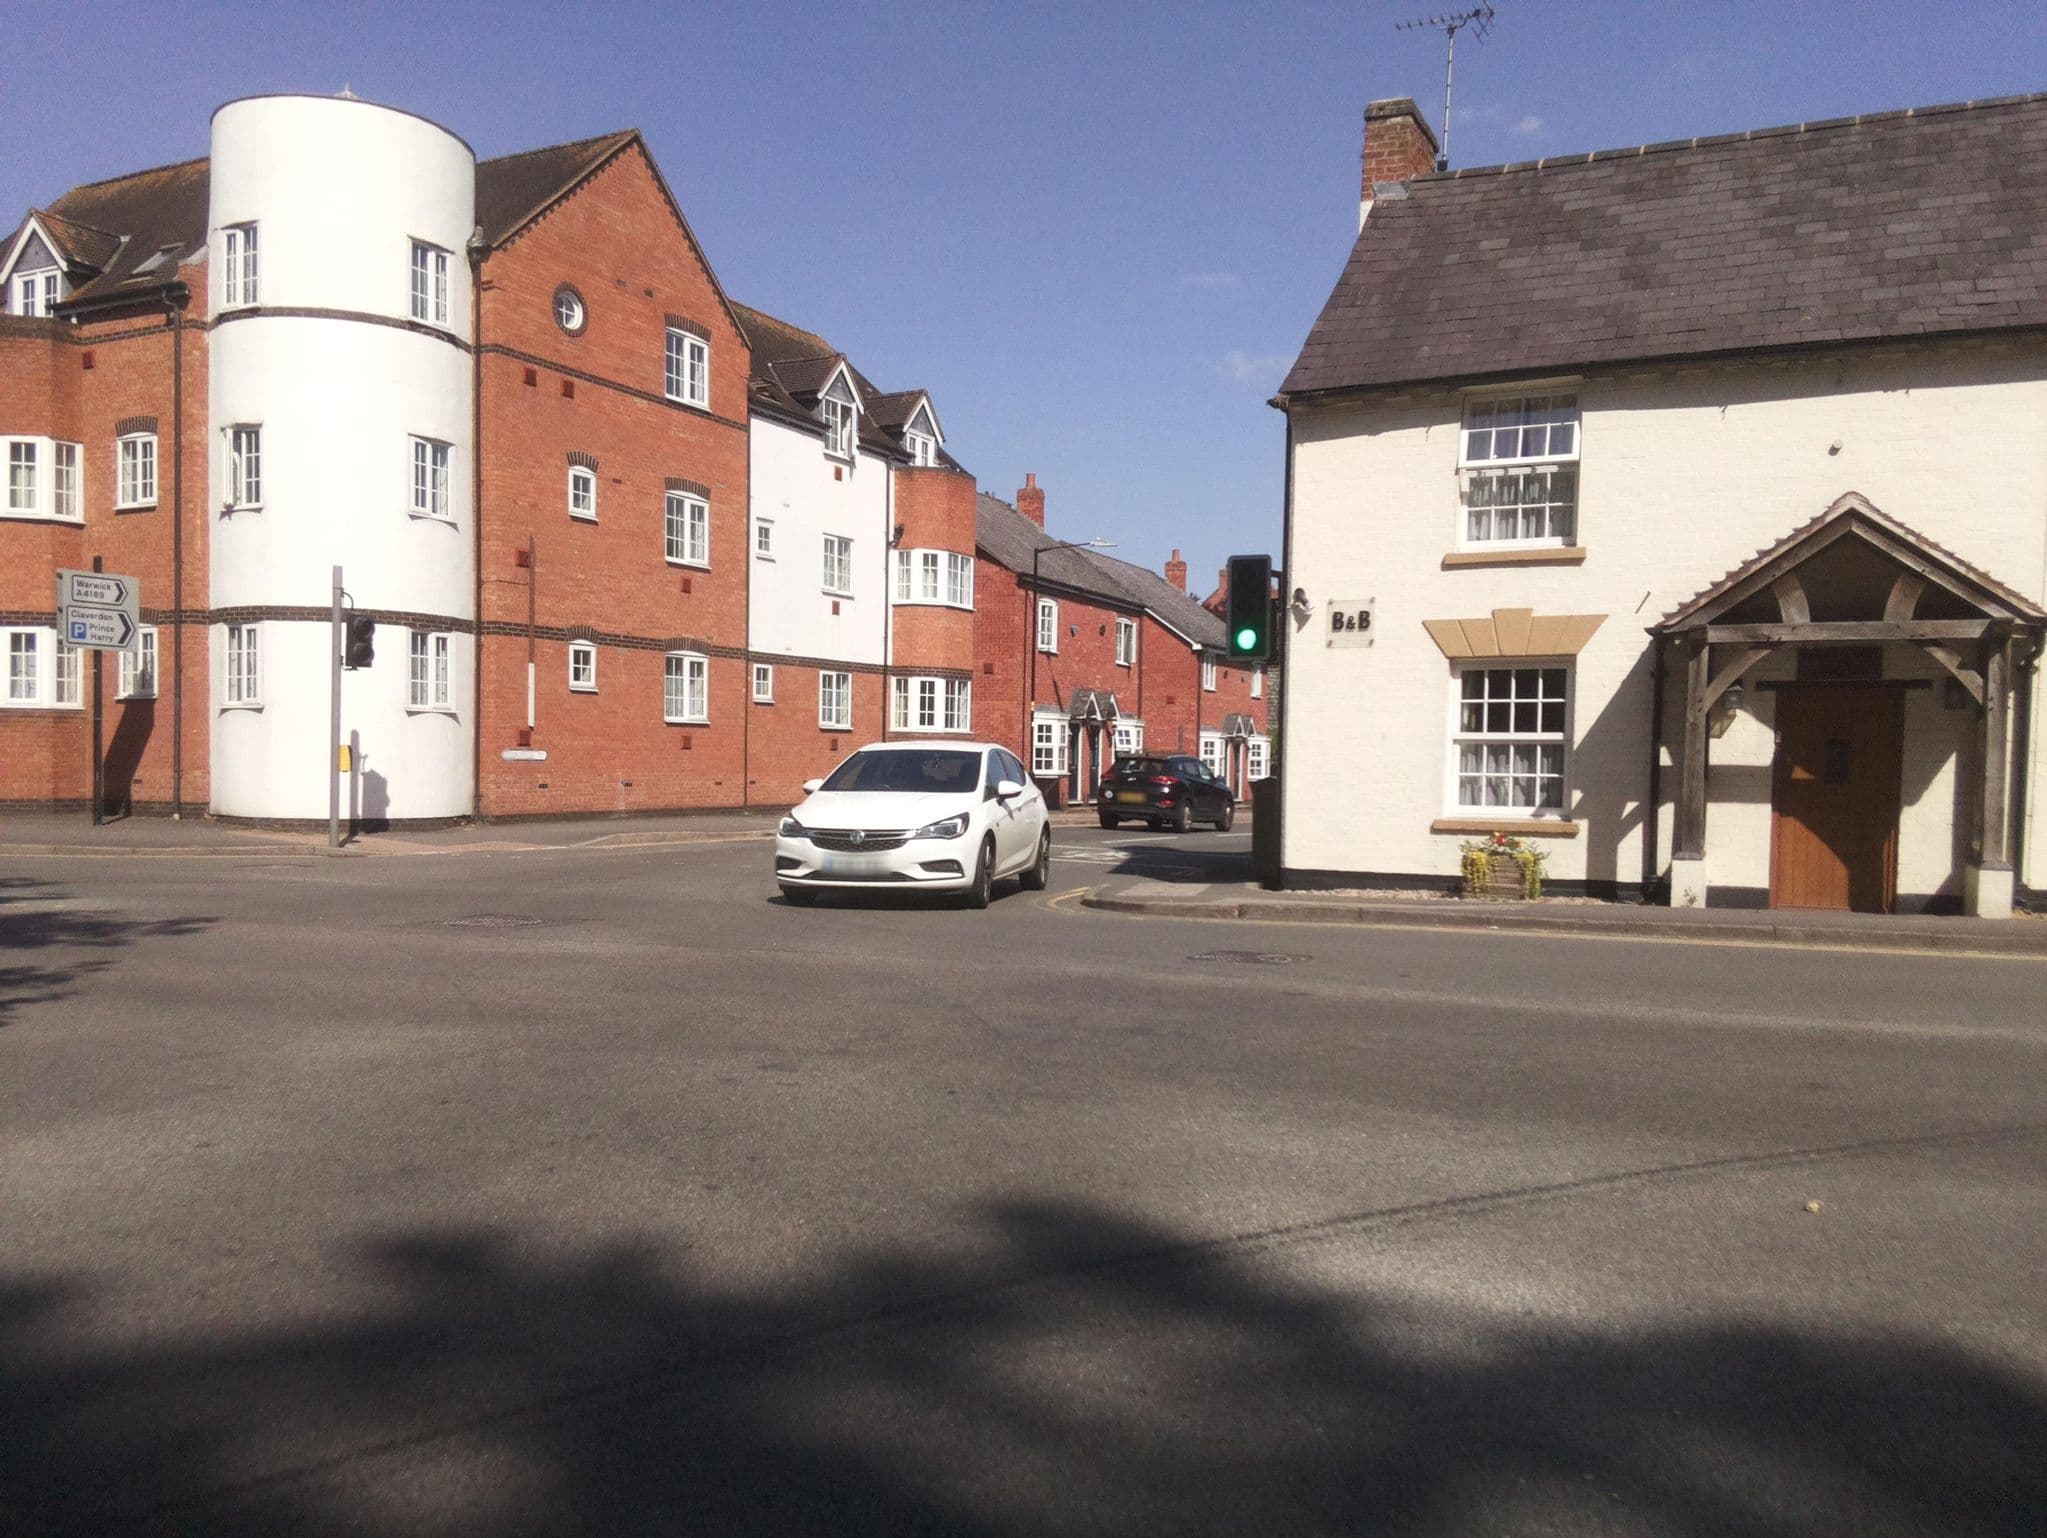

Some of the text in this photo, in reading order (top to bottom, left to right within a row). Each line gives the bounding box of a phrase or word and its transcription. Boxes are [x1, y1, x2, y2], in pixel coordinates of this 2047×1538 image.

[76, 580, 111, 591] Warwick
[76, 590, 105, 599] A4189
[71, 610, 113, 621] Claverdon
[1332, 611, 1370, 631] B&B
[74, 623, 85, 637] P
[89, 623, 115, 633] Prince
[91, 633, 113, 642] Harry
